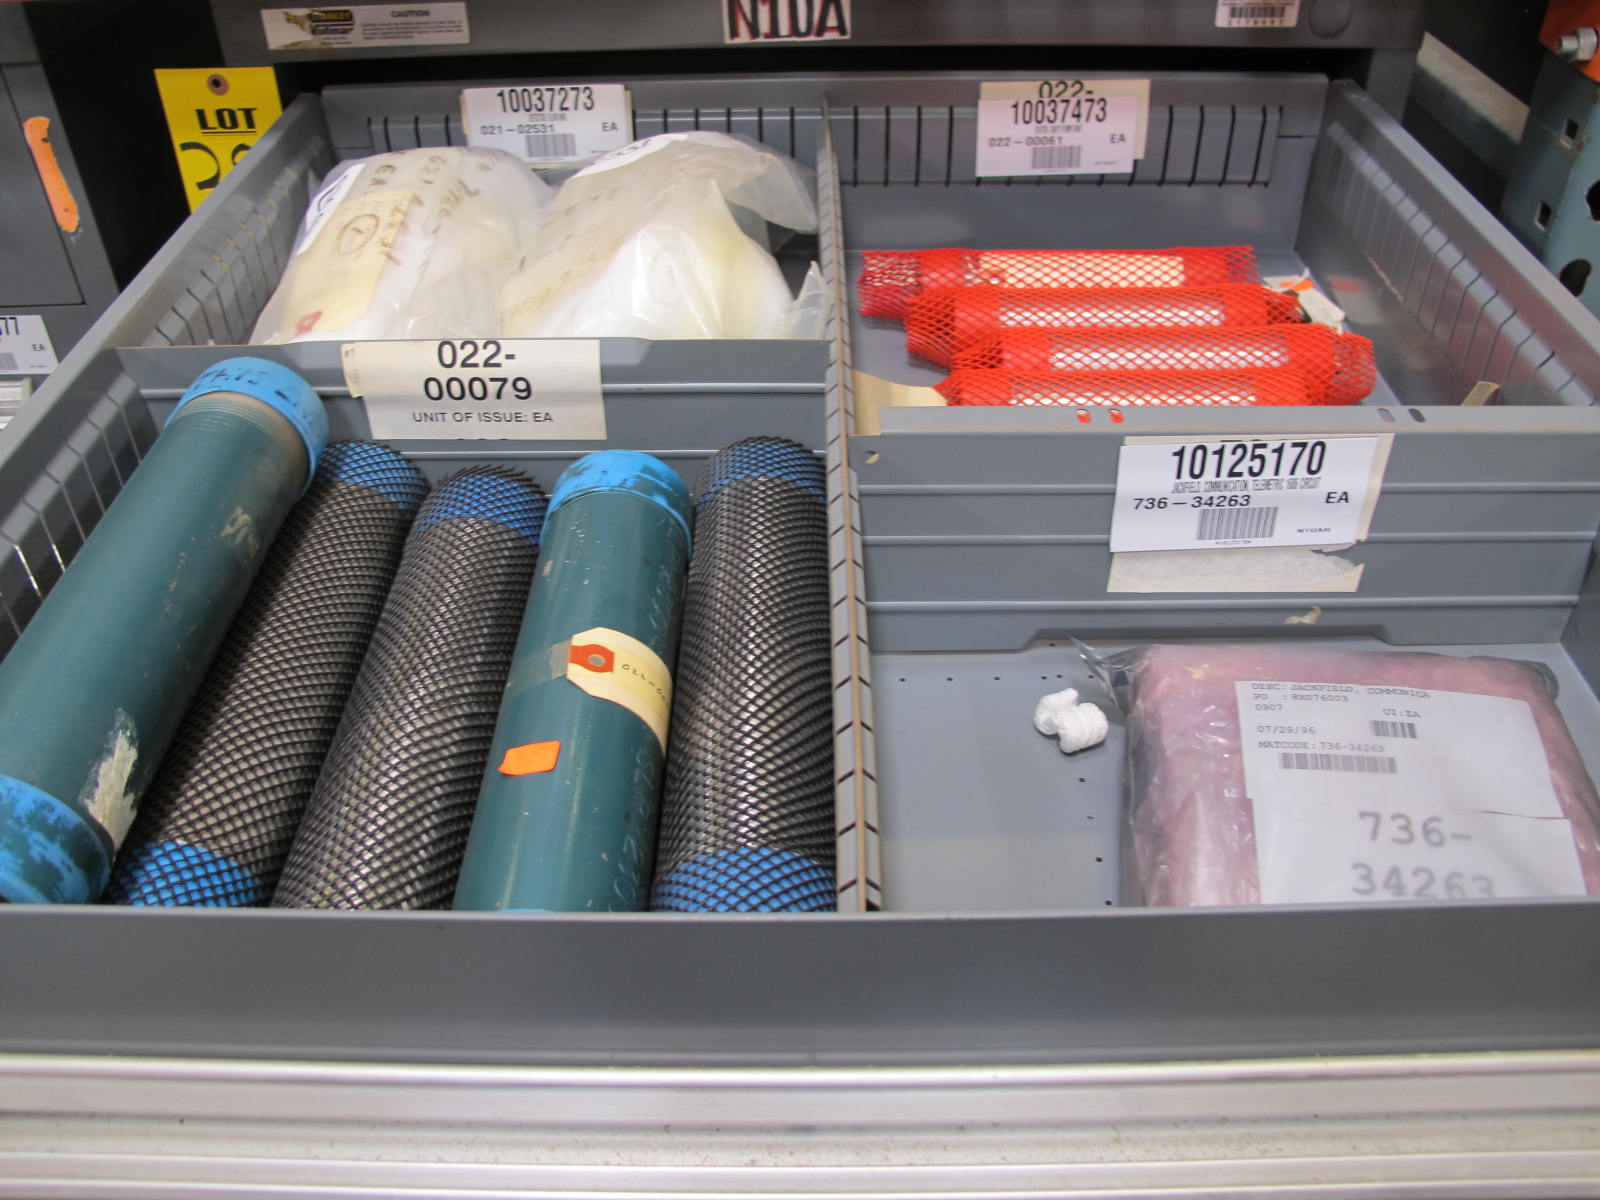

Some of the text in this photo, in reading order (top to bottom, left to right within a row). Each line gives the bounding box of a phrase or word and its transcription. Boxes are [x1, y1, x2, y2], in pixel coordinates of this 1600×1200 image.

[1038, 80, 1094, 98] 022-
[497, 86, 594, 113] 10037273
[195, 107, 258, 130] LOT
[1011, 98, 1108, 125] 10037473
[601, 122, 619, 132] EA
[1109, 134, 1126, 144] EA
[0, 316, 19, 335] 77
[32, 344, 47, 352] EA
[437, 340, 516, 369] 022-
[424, 376, 532, 401] 00079
[412, 412, 553, 423] UNIT OF ISSUE: EA
[1171, 440, 1327, 480] 10125170
[1325, 491, 1350, 504] EA
[1252, 683, 1287, 691] DESC:
[1257, 725, 1316, 735] 07/29/96
[1358, 811, 1472, 848] 736-
[1351, 862, 1496, 899] 34263
